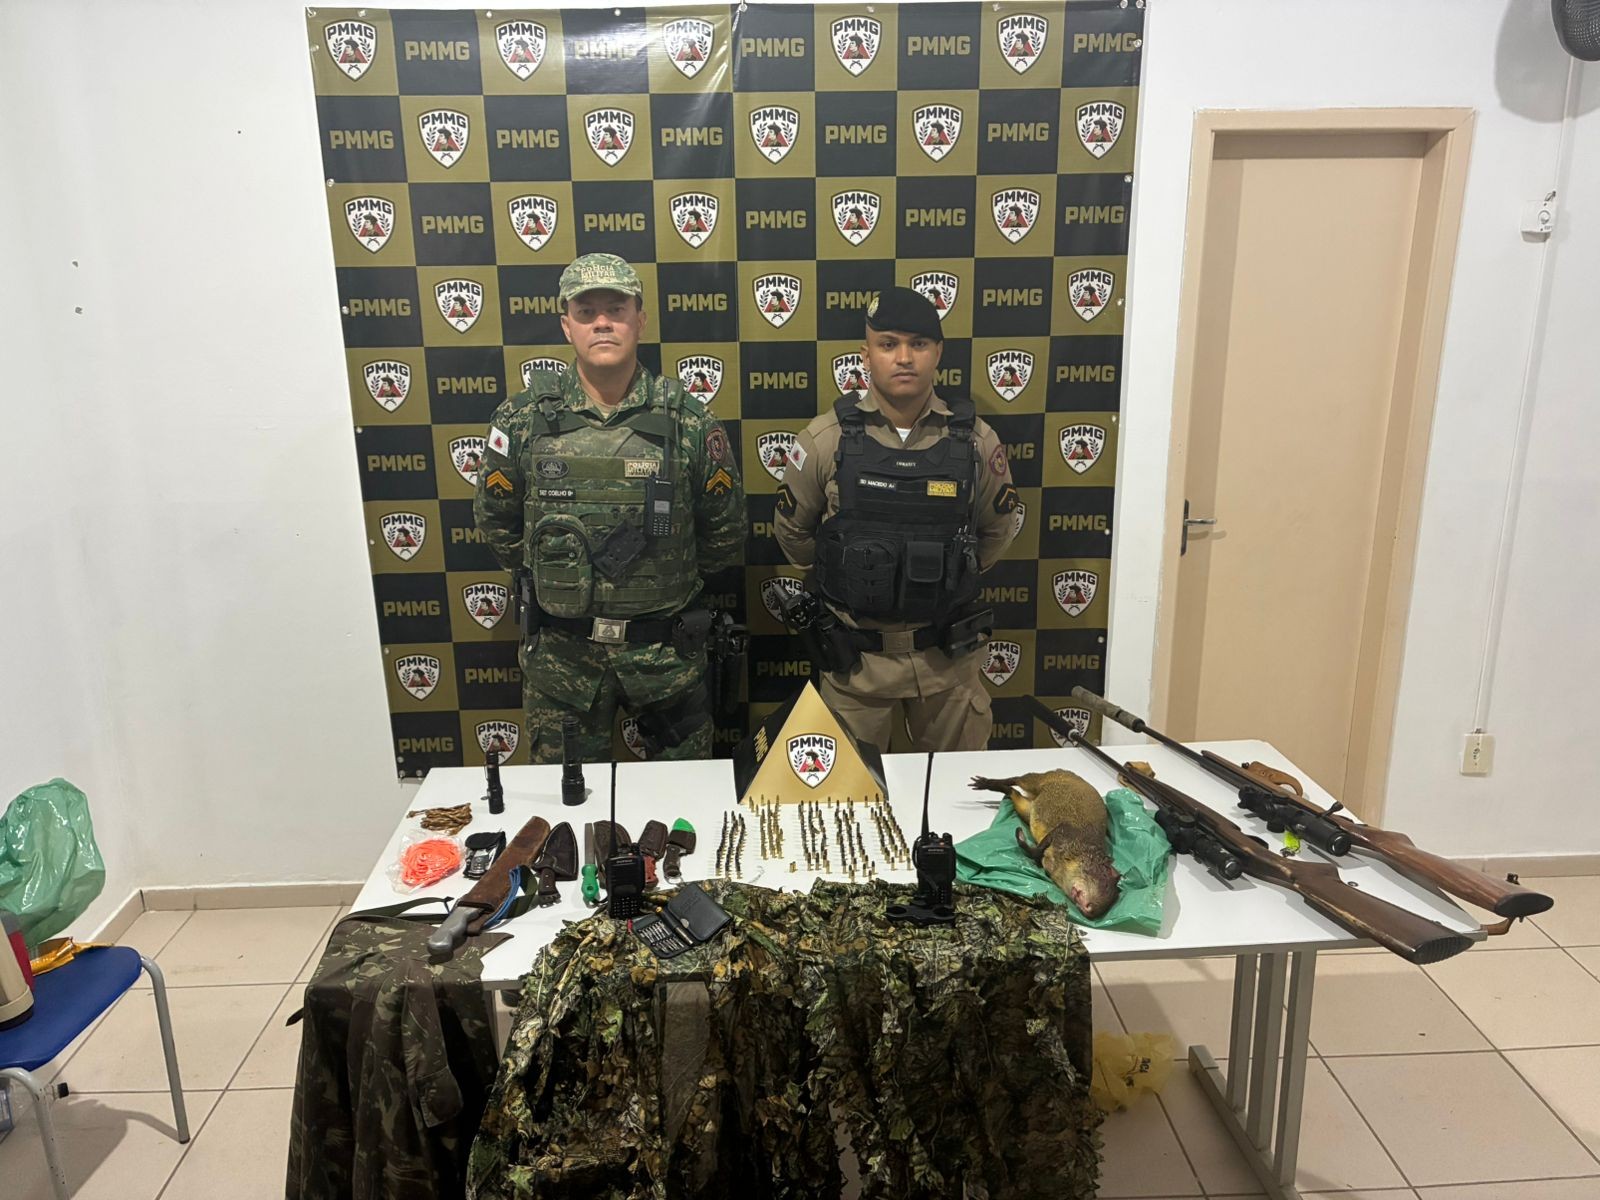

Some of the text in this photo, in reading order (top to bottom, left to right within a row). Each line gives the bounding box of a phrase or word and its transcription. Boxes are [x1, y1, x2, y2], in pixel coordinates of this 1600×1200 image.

[327, 20, 374, 41] PMMG
[499, 21, 543, 40] PMMG
[665, 20, 711, 37] PMMG
[834, 20, 878, 36] PMMG
[1001, 17, 1045, 34] PMMG
[405, 41, 469, 61] PMMG
[741, 37, 805, 57] PMMG
[907, 36, 971, 56] PMMG
[1073, 33, 1137, 52] PMMG
[421, 111, 466, 129] PMMG
[587, 110, 632, 127] PMMG
[752, 109, 796, 125] PMMG
[916, 107, 959, 123] PMMG
[1078, 104, 1122, 120] PMMG
[330, 130, 394, 149] PMMG
[497, 129, 559, 149] PMMG
[661, 127, 723, 146] PMMG
[825, 124, 887, 144] PMMG
[987, 123, 1049, 142] PMMG
[347, 197, 392, 215] PMMG
[511, 196, 555, 215] PMMG
[673, 194, 716, 211] PMMG
[834, 193, 878, 209] PMMG
[995, 191, 1038, 208] PMMG
[584, 213, 645, 232] PMMG
[746, 210, 806, 229] PMMG
[906, 208, 966, 226] PMMG
[1065, 205, 1124, 223] PMMG
[422, 215, 484, 234] PMMG
[756, 277, 798, 292] PMMG
[914, 274, 957, 289] PMMG
[1070, 271, 1112, 286] PMMG
[437, 281, 481, 297] PMMG
[983, 288, 1043, 306] PMMG
[349, 298, 411, 316] PMMG
[668, 294, 727, 312] PMMG
[680, 358, 721, 373] PMMG
[835, 354, 863, 370] PMM
[990, 353, 1031, 369] PMMG
[366, 363, 408, 379] PMMG
[933, 368, 961, 386] MG
[1056, 365, 1114, 382] PMMG
[437, 377, 497, 394] PMMG
[750, 372, 808, 389] PMMG
[1062, 427, 1104, 443] PMMG
[452, 439, 485, 455] PMM
[1005, 442, 1034, 459] MG
[367, 455, 426, 471] PMMG
[867, 480, 888, 488] MACEDO
[383, 515, 424, 531] PMMG
[1049, 514, 1107, 531] PMMG
[1055, 572, 1096, 586] PMMG
[465, 585, 507, 600] PMMG
[383, 600, 440, 616] PMMG
[988, 643, 1018, 656] MMG
[396, 657, 438, 672] PMMG
[757, 661, 811, 676] PMMG
[1044, 655, 1100, 670] PMMG
[465, 668, 521, 684] PMMG
[478, 723, 519, 737] PMMG
[399, 738, 453, 752] PMMG
[754, 725, 769, 763] PMMG
[789, 735, 834, 751] PMMG
